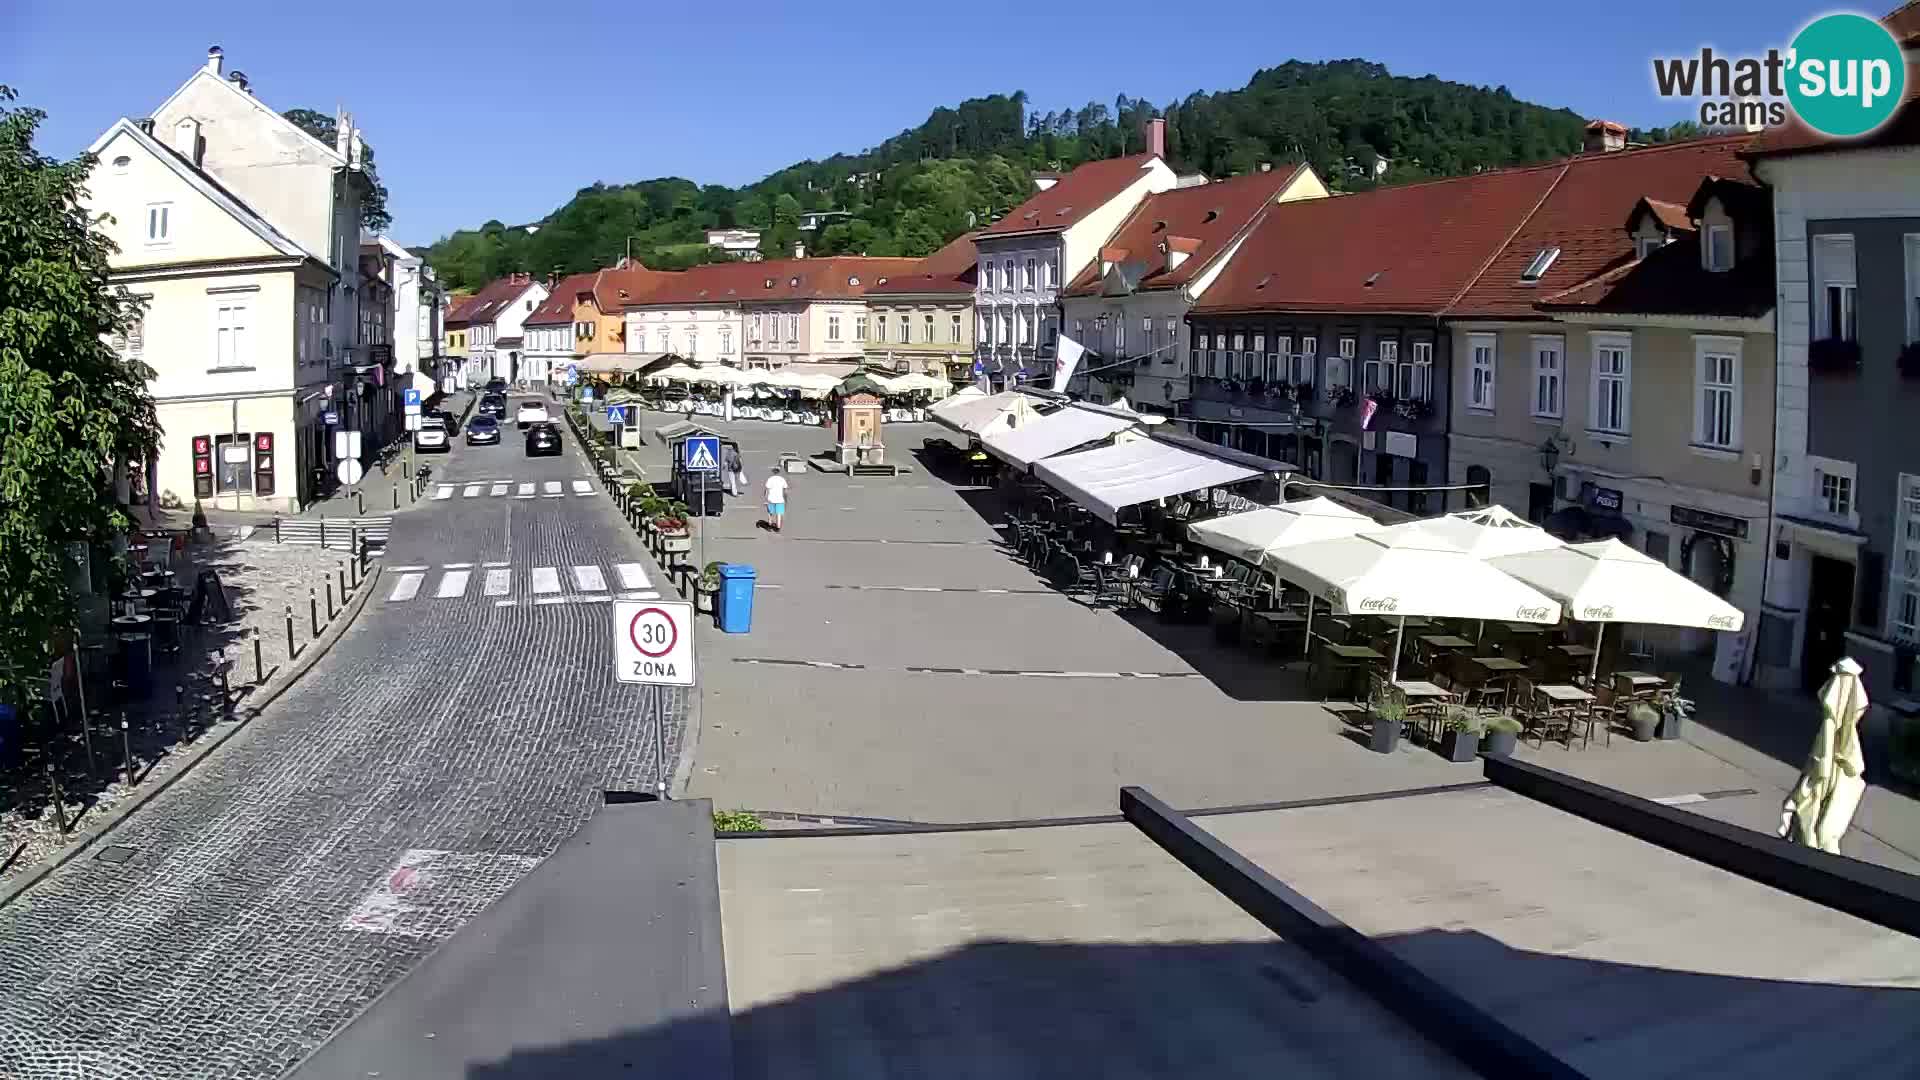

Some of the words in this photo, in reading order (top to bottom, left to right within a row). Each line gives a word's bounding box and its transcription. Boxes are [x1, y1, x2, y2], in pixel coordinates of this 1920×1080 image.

[408, 392, 417, 403] P
[642, 623, 666, 645] 30
[633, 661, 677, 677] ZONA
